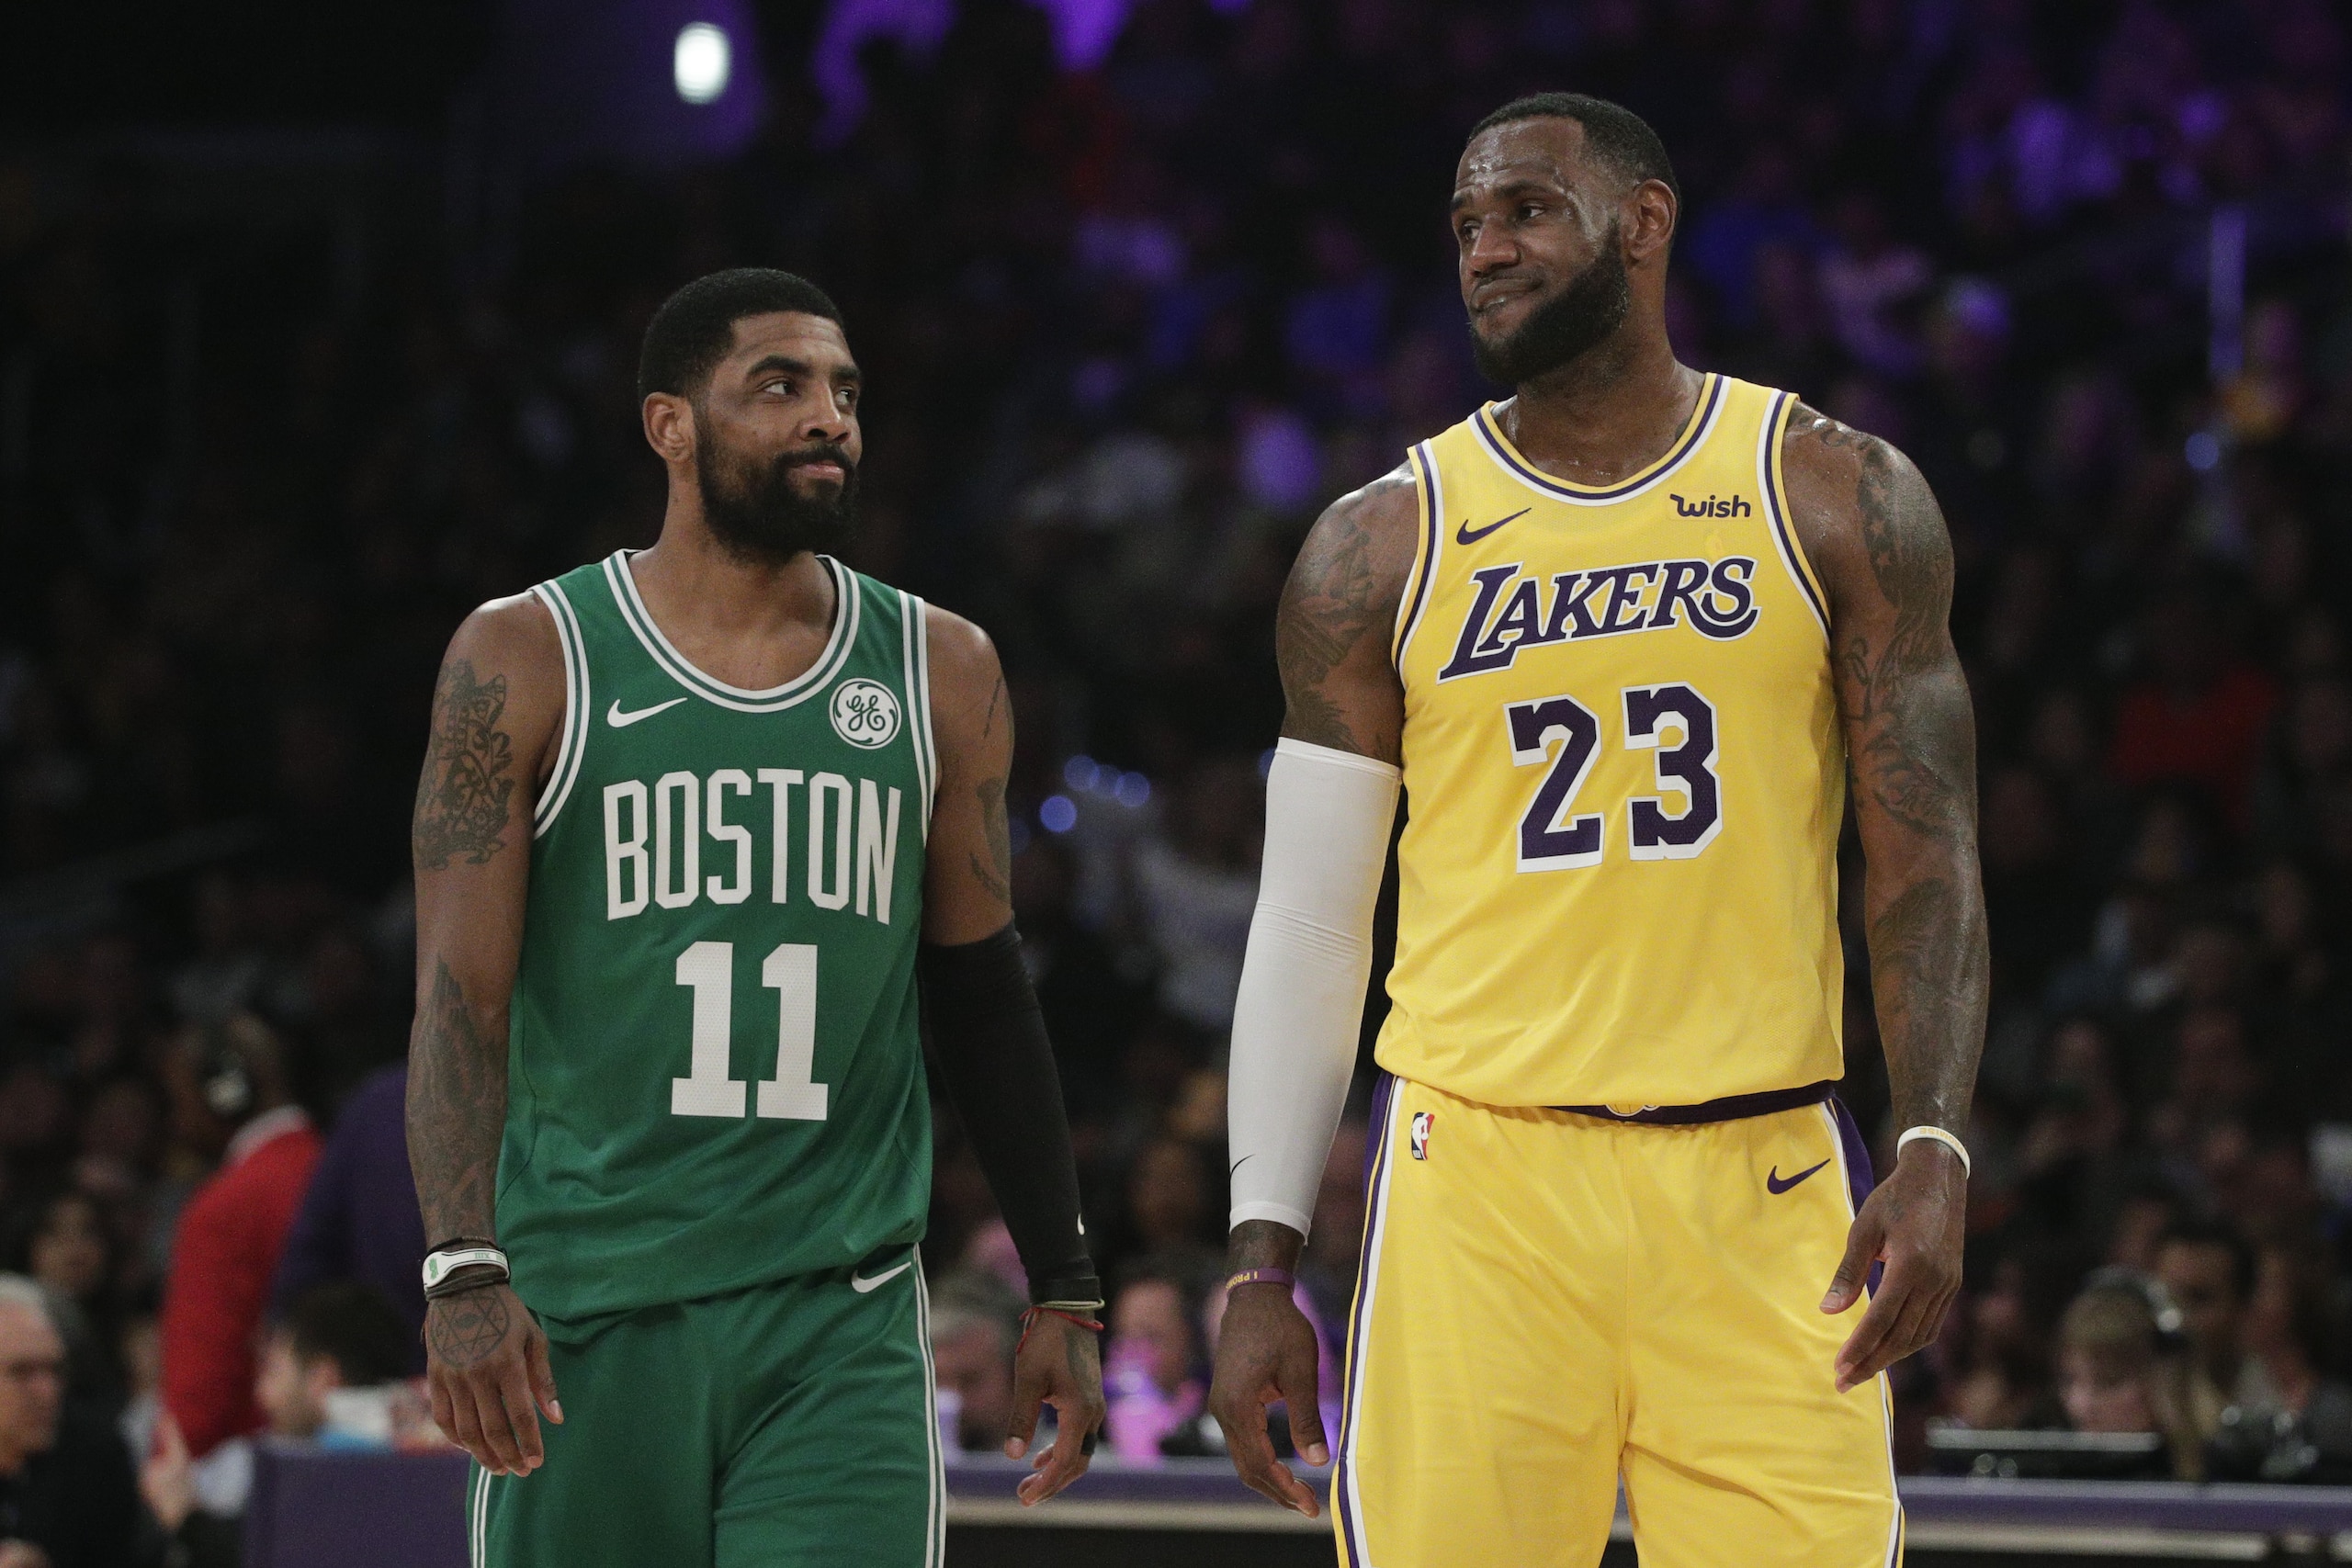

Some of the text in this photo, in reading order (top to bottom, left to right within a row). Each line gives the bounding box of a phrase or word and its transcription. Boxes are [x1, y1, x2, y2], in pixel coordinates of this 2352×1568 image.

[1669, 493, 1751, 518] wish
[1436, 555, 1763, 685] LAKERS
[604, 768, 902, 925] BOSTON
[1503, 681, 1724, 874] 23
[671, 941, 829, 1122] 11
